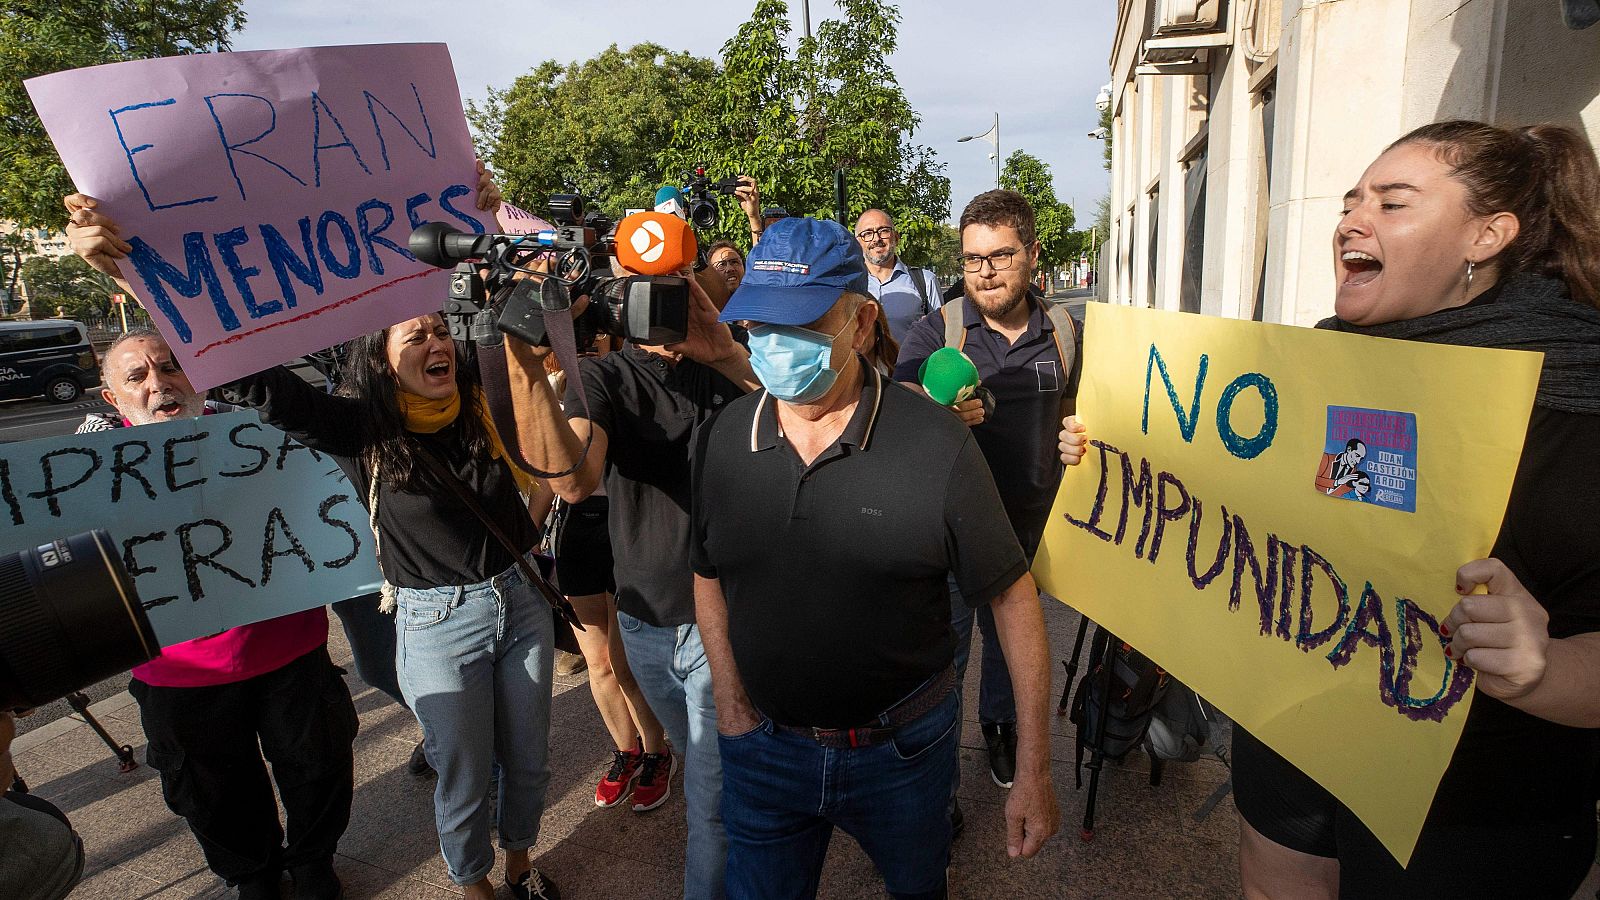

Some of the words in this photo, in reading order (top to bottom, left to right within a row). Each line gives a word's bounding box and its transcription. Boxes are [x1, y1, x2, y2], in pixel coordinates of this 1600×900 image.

[110, 82, 437, 211] ERAN
[1141, 343, 1279, 460] NO
[1379, 451, 1403, 465] JUAN
[1367, 461, 1414, 480] CASTEJÓN
[1375, 475, 1405, 490] ARDID
[861, 507, 882, 516] BOSS
[1063, 439, 1476, 723] IMPUNIDAD
